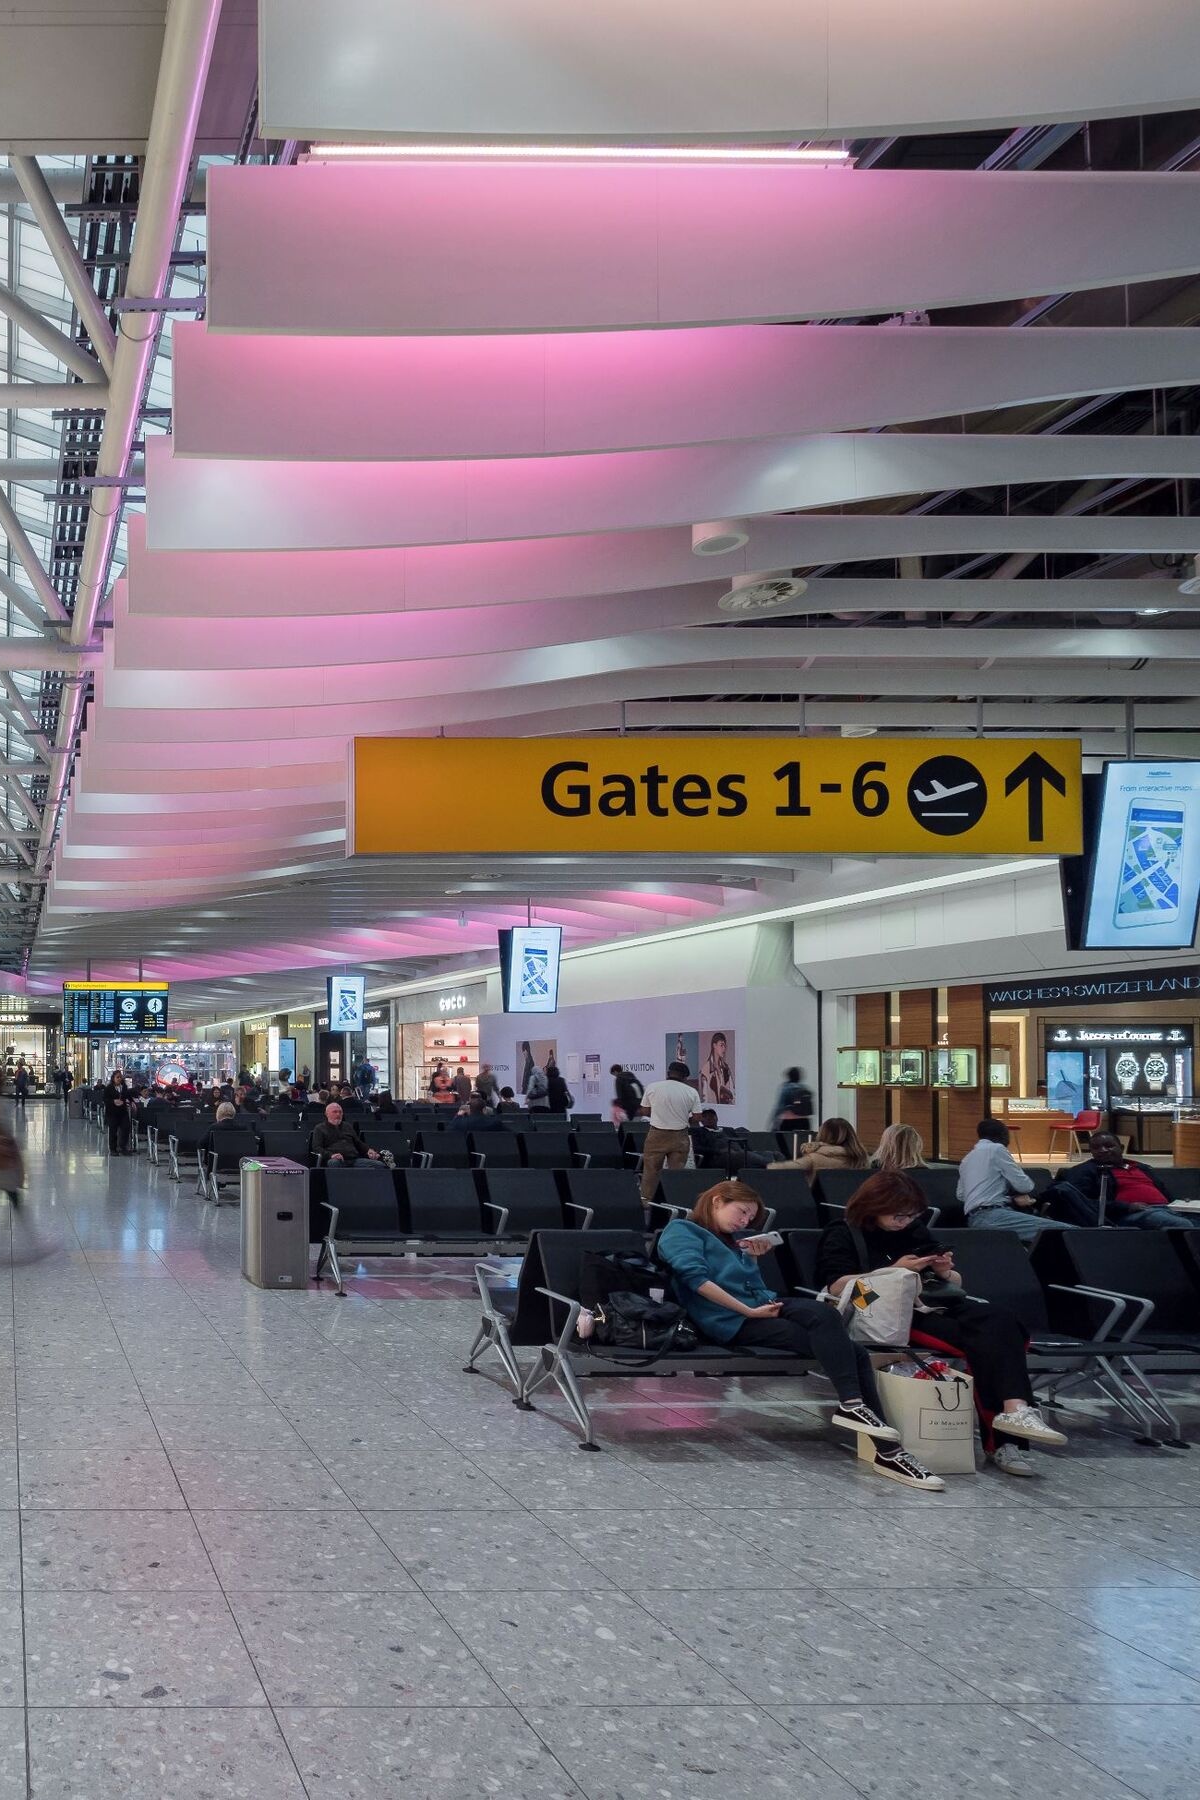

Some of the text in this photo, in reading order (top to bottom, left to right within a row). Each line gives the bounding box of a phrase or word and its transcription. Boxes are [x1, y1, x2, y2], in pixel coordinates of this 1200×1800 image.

[542, 761, 890, 819] Gates 1-6
[1139, 784, 1173, 792] interactive
[989, 986, 1061, 1003] WATCHES
[1074, 976, 1200, 997] SWITZERLAND
[439, 995, 466, 1011] GUCCI
